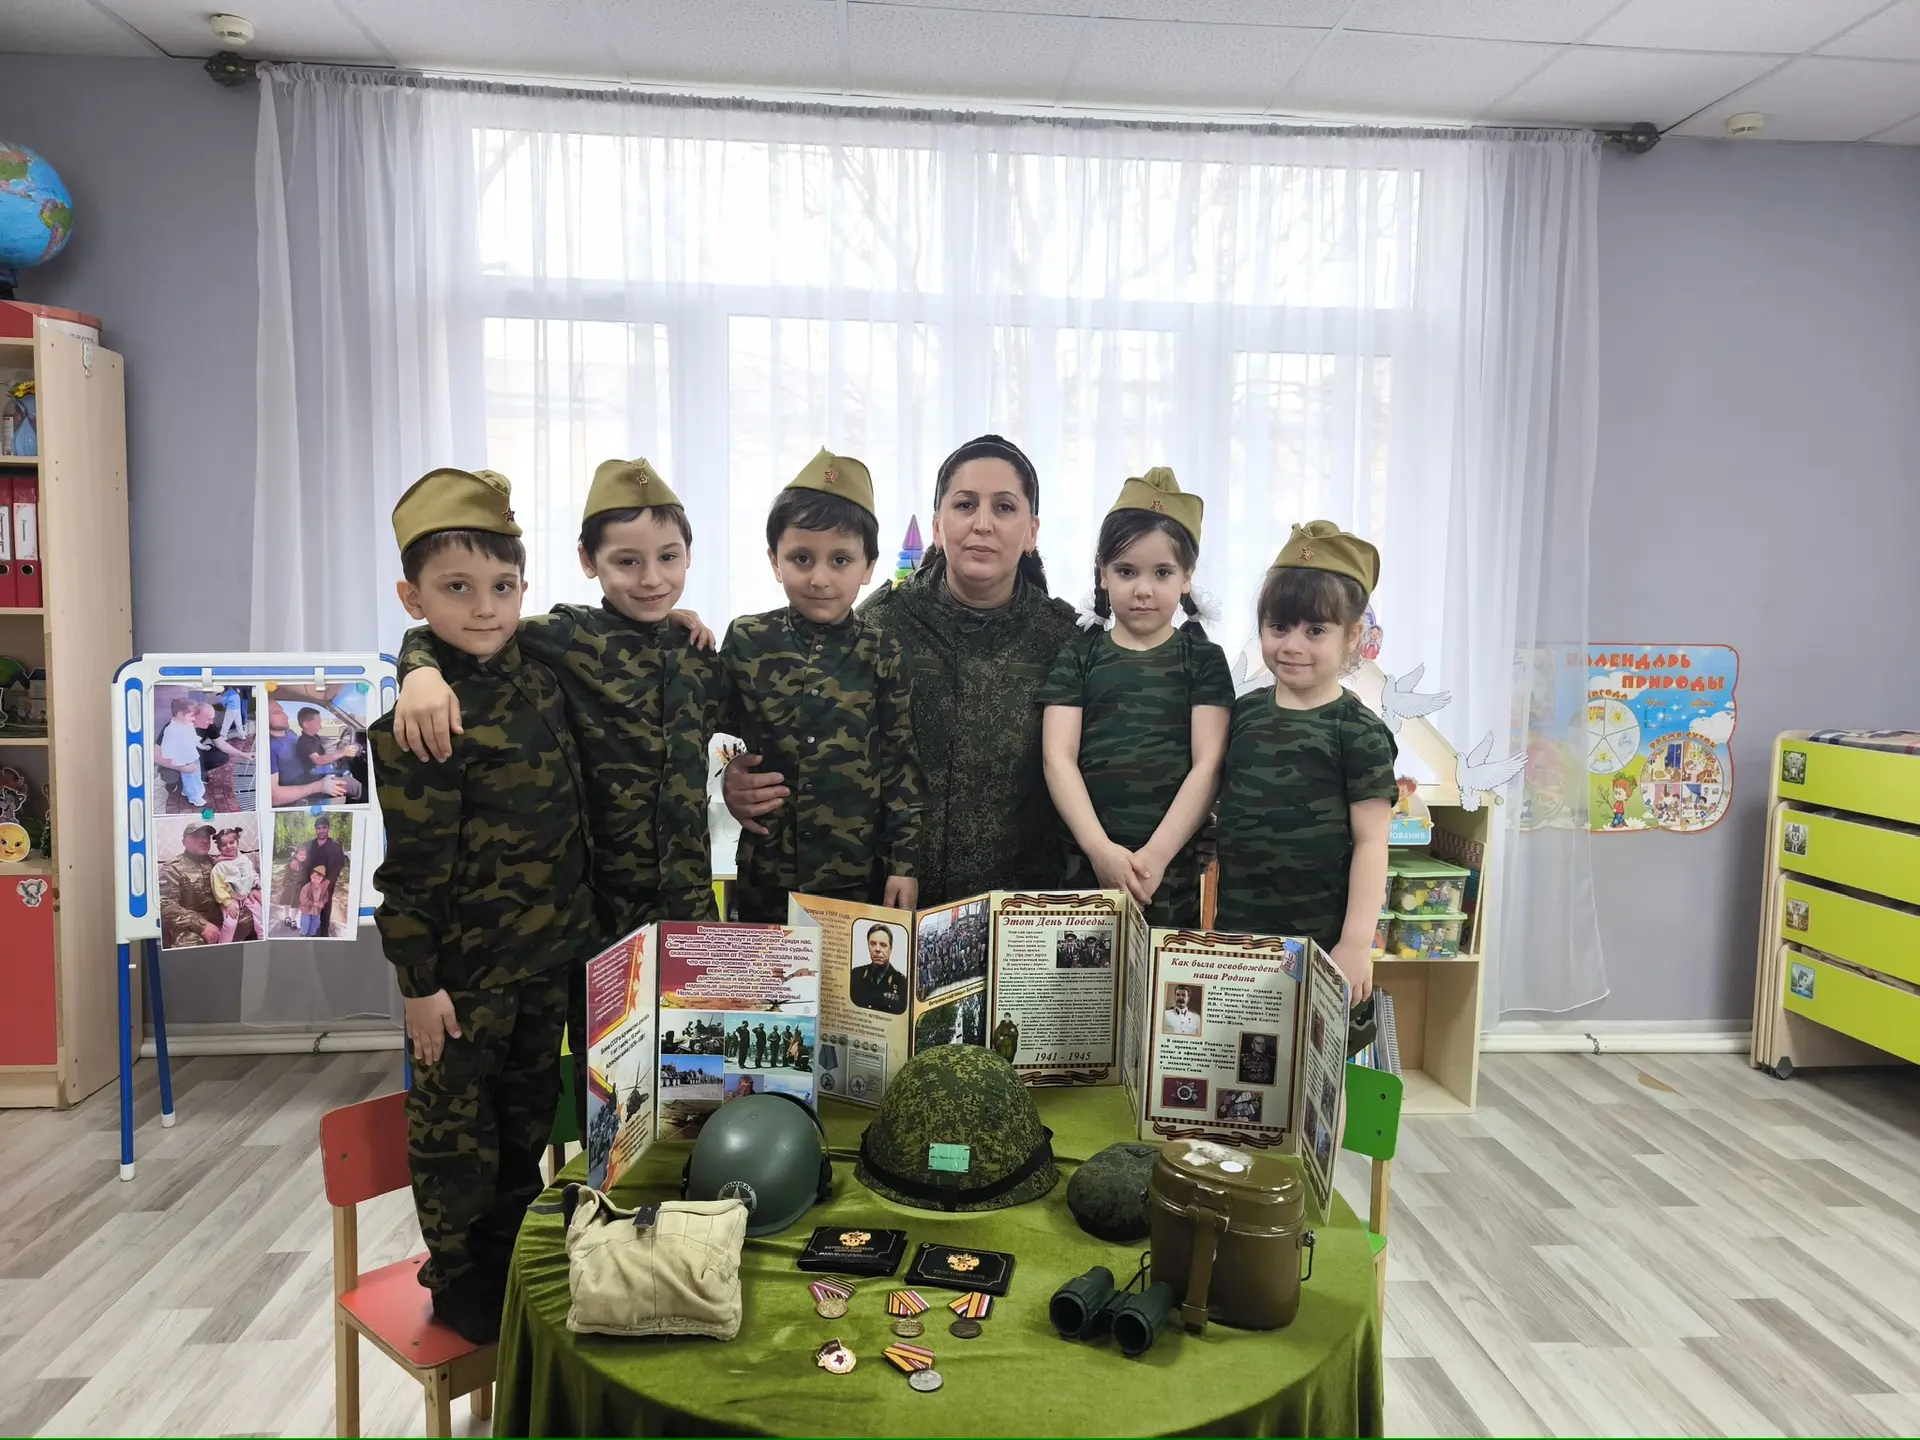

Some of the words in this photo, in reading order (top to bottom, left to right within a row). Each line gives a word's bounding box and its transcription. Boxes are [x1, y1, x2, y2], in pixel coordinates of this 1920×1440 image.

[1622, 676, 1724, 691] ПРИРОДЫ
[1002, 917, 1034, 926] Этот
[1036, 917, 1062, 927] День
[1065, 917, 1114, 926] Победы...
[1171, 957, 1189, 966] Как
[1191, 959, 1215, 969] была
[1217, 961, 1280, 973] освобождена
[1193, 972, 1218, 980] наша
[1221, 973, 1255, 983] Родина
[1034, 1052, 1057, 1061] 1941
[1069, 1052, 1092, 1061] 1945
[721, 1181, 753, 1192] COMBAT
